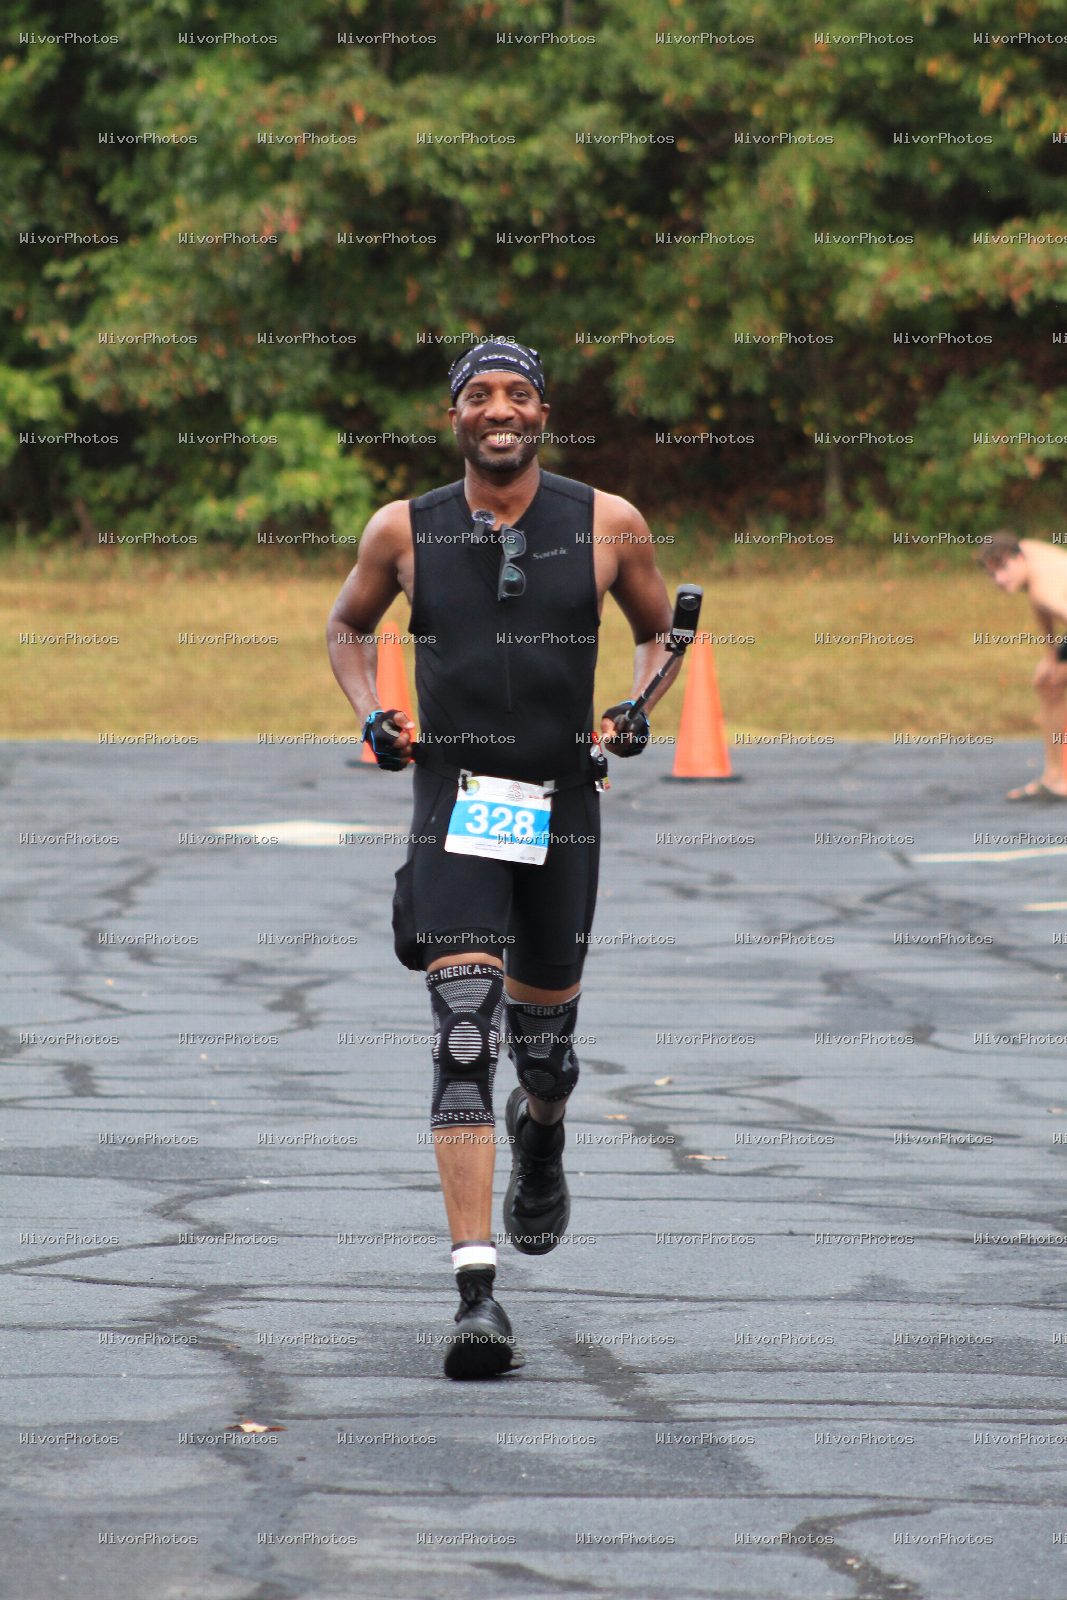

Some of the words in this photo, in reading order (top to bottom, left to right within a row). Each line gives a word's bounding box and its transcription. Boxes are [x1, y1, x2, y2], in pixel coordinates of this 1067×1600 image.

[465, 803, 535, 841] 328
[439, 964, 482, 980] NEENCA
[523, 1005, 564, 1016] NEENCA
